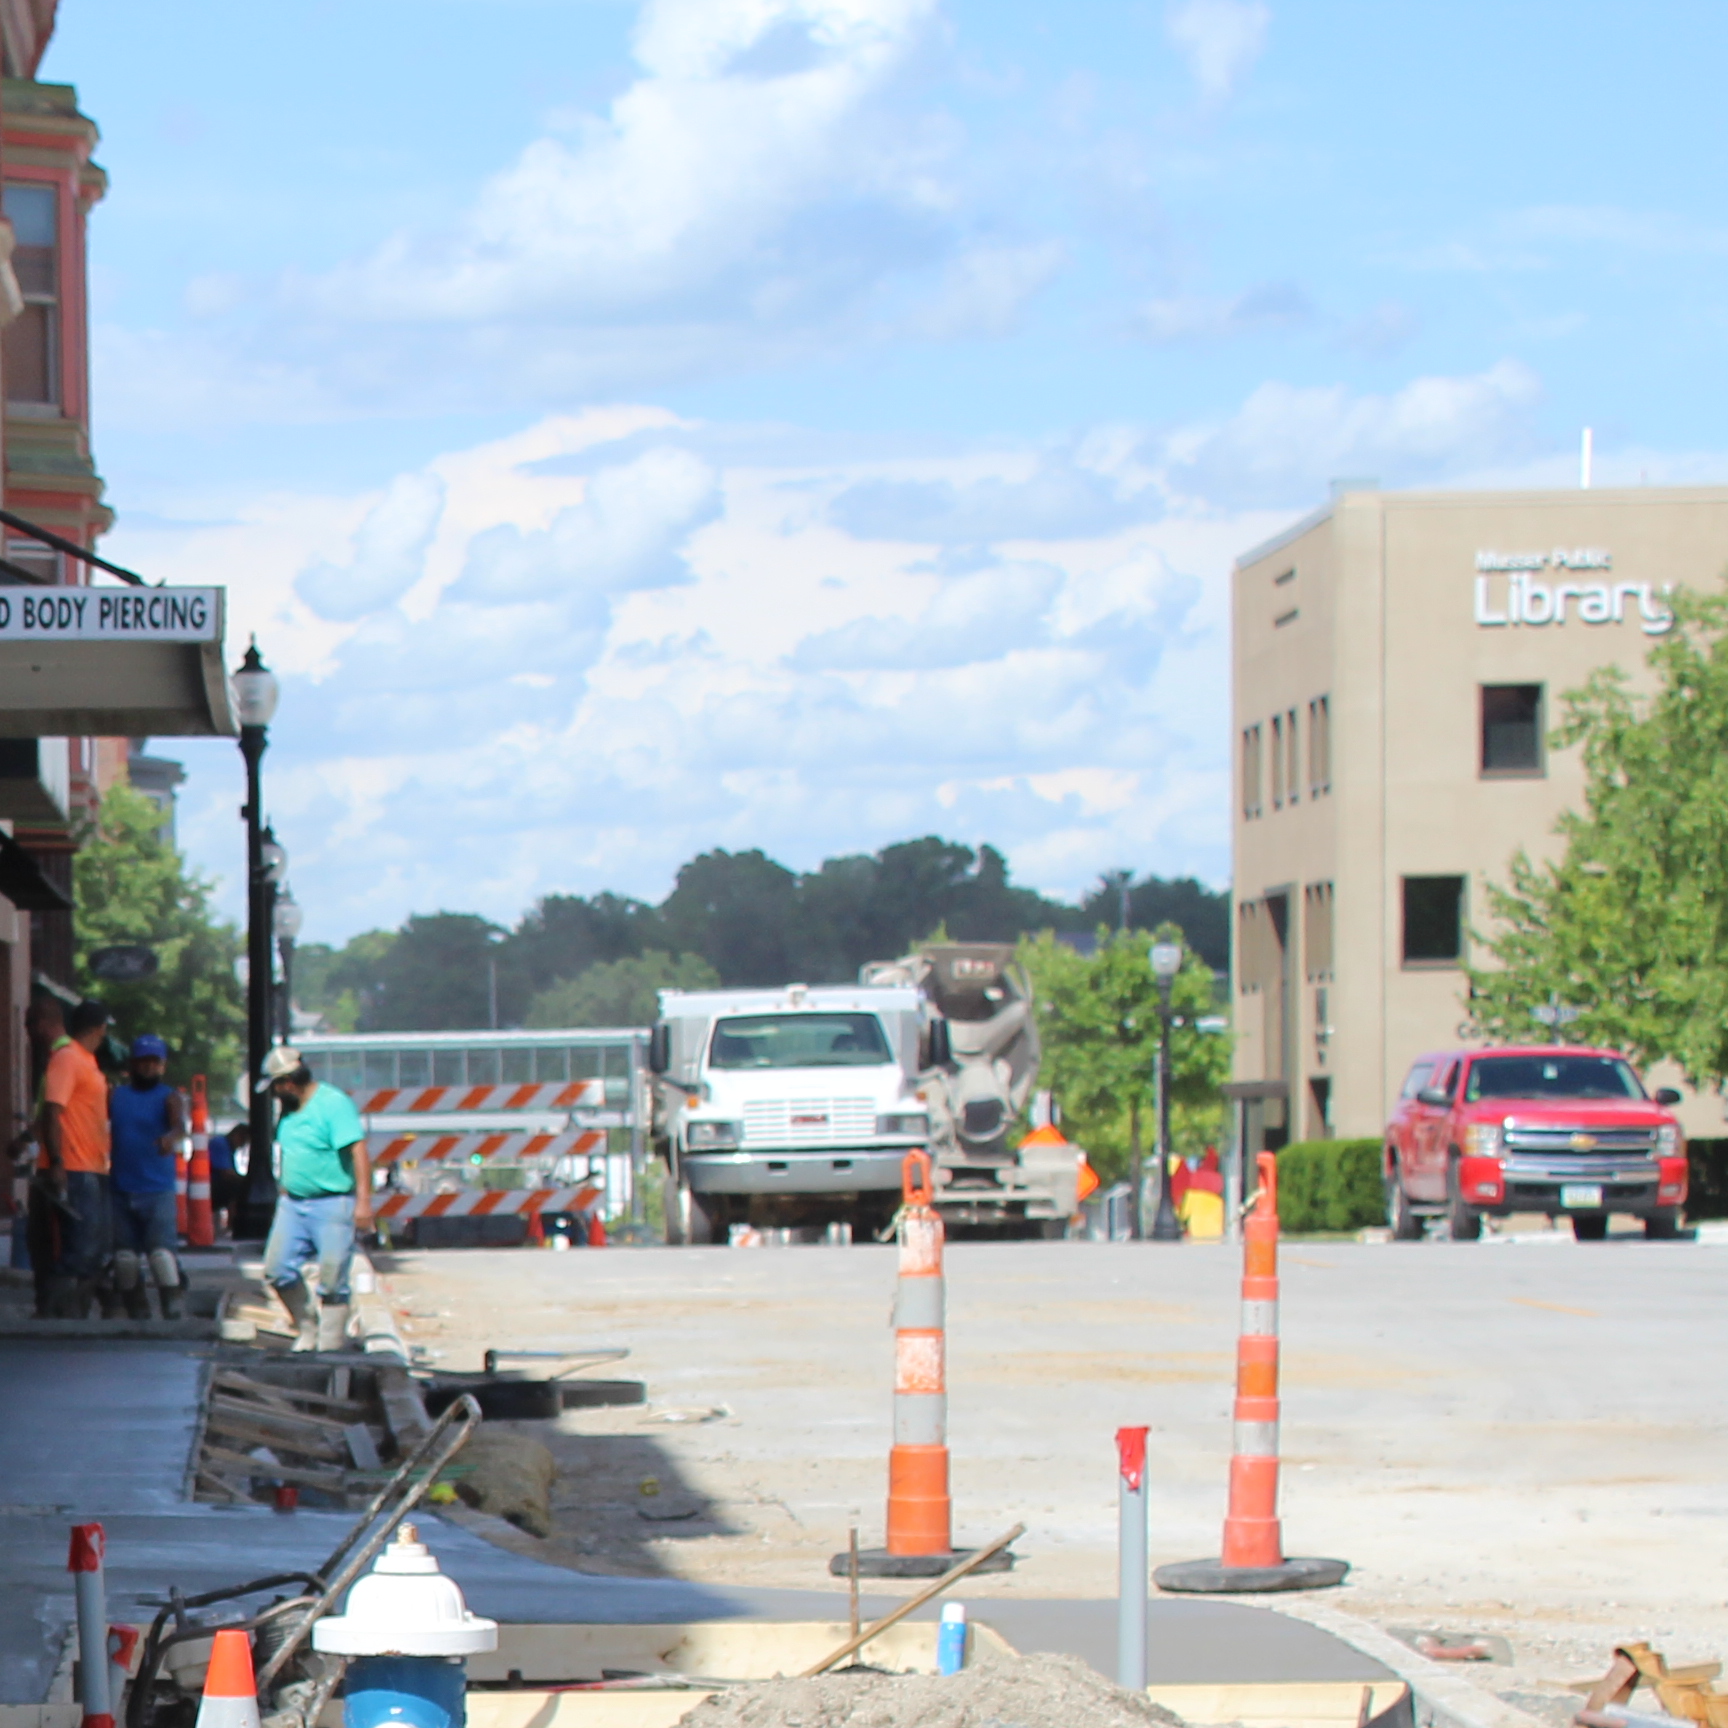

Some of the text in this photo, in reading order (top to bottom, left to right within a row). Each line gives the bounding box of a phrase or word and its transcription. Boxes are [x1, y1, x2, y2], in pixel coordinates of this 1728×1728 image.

[1551, 548, 1613, 570] Public
[23, 597, 88, 630] BODY
[98, 597, 208, 630] PIERCING
[1474, 572, 1675, 635] Library
